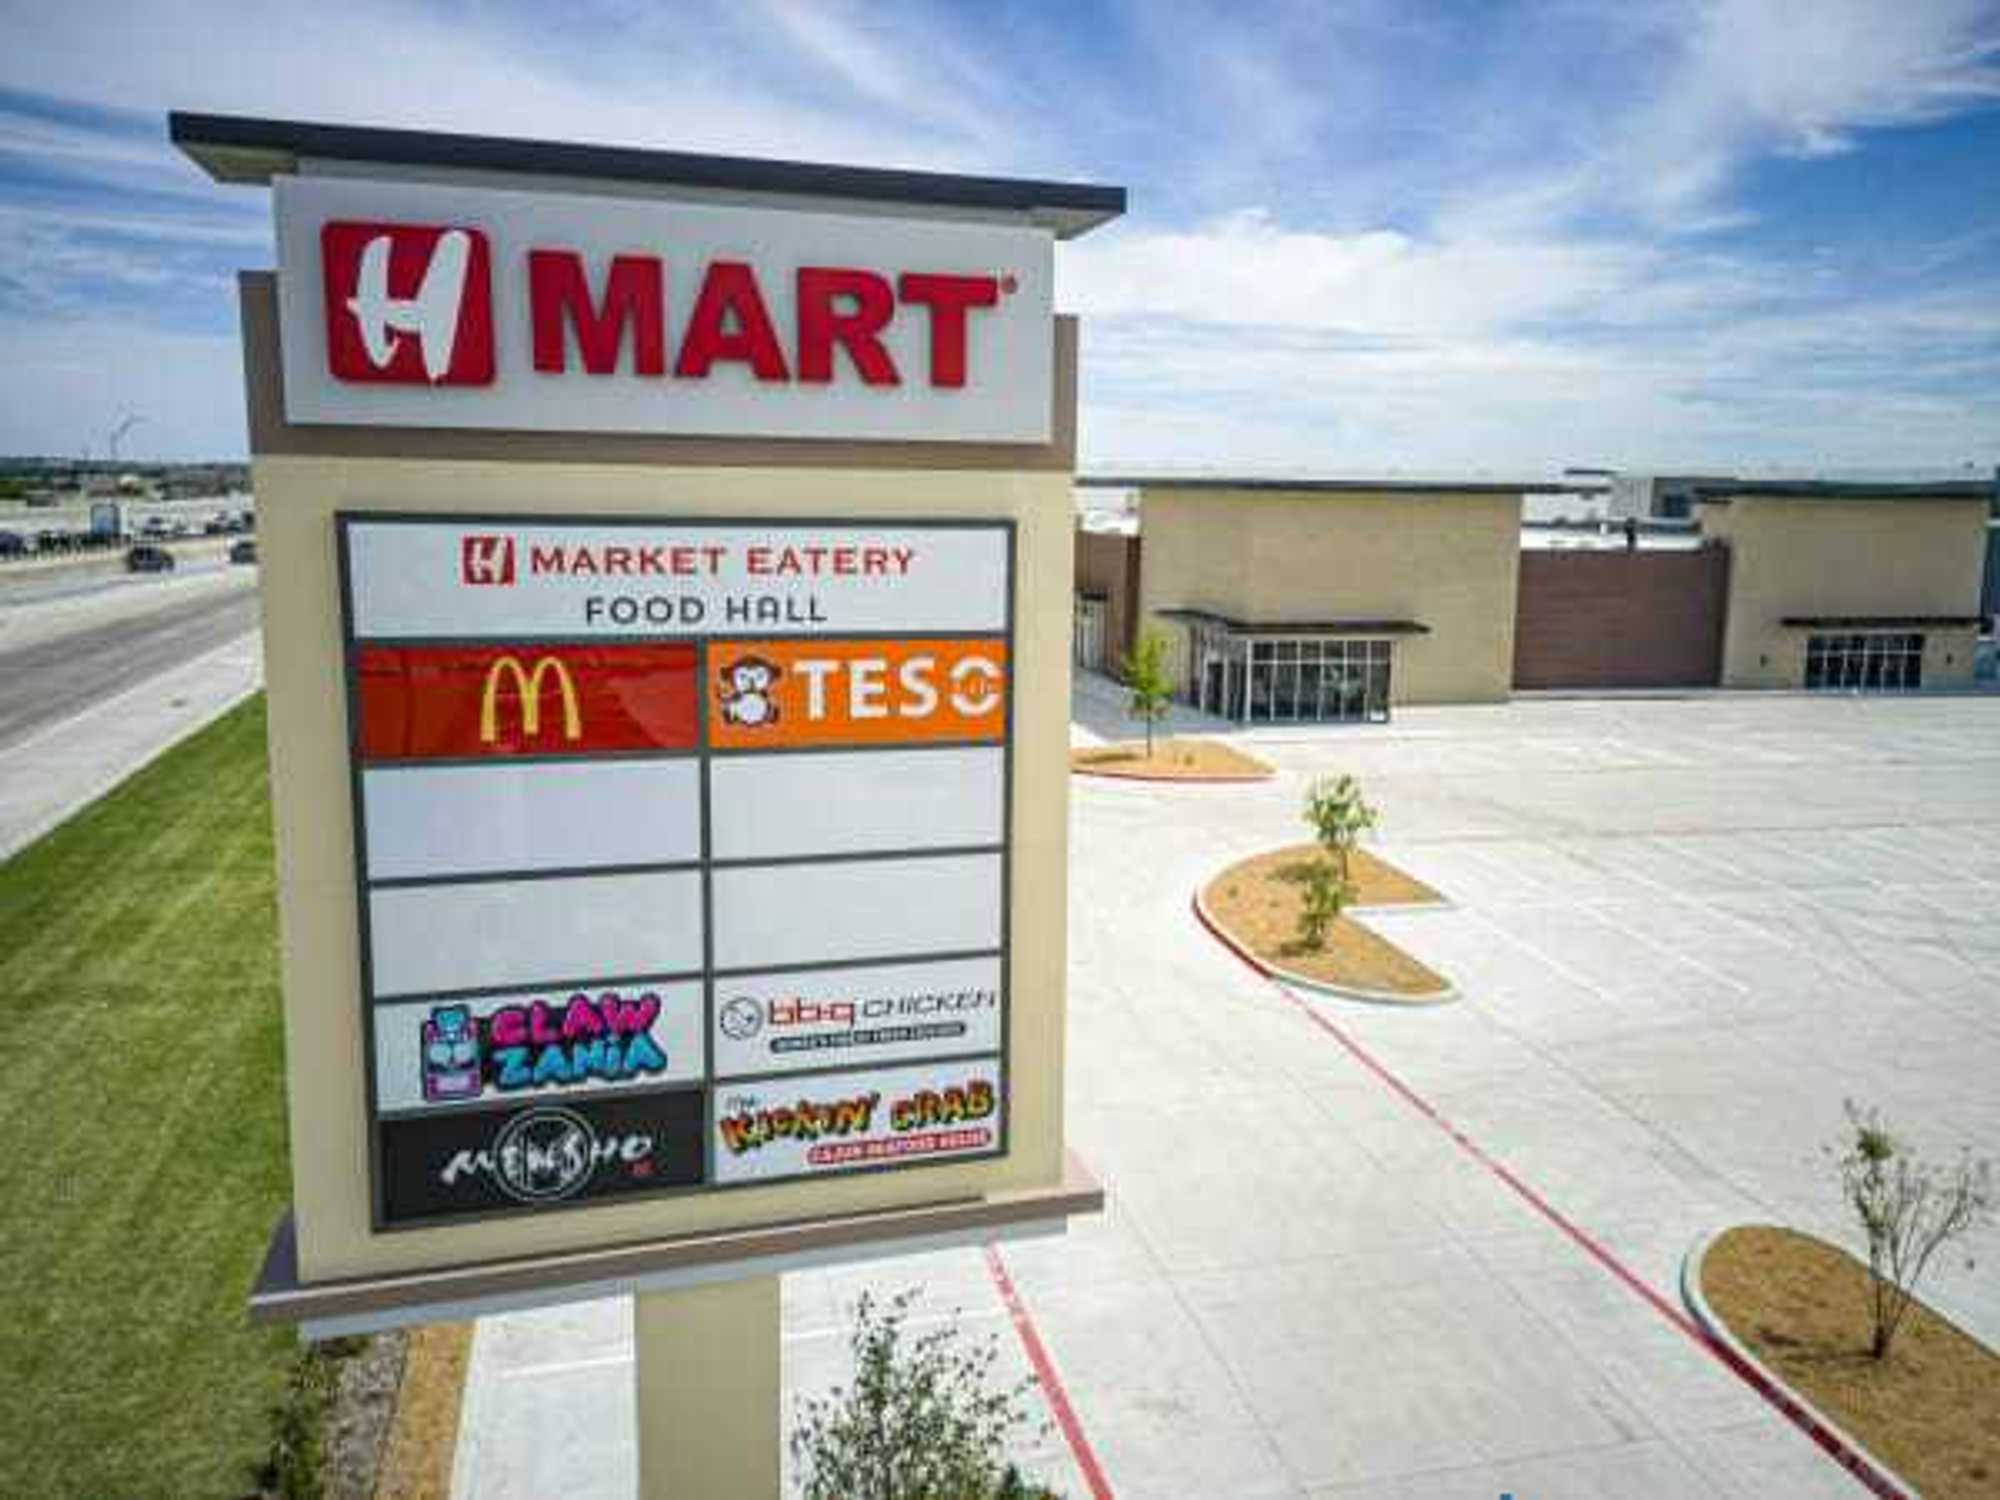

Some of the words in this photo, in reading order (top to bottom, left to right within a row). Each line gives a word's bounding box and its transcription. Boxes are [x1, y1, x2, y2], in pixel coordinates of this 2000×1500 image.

[528, 249, 999, 389] MART
[531, 546, 727, 575] MARKET
[747, 546, 913, 575] EATERY
[586, 595, 705, 626] FOOD
[726, 593, 828, 624] HALL
[793, 655, 1000, 721] TESO
[490, 992, 661, 1046] CLAW
[863, 991, 995, 1018] CHICKEN
[891, 1080, 995, 1132] CRAB
